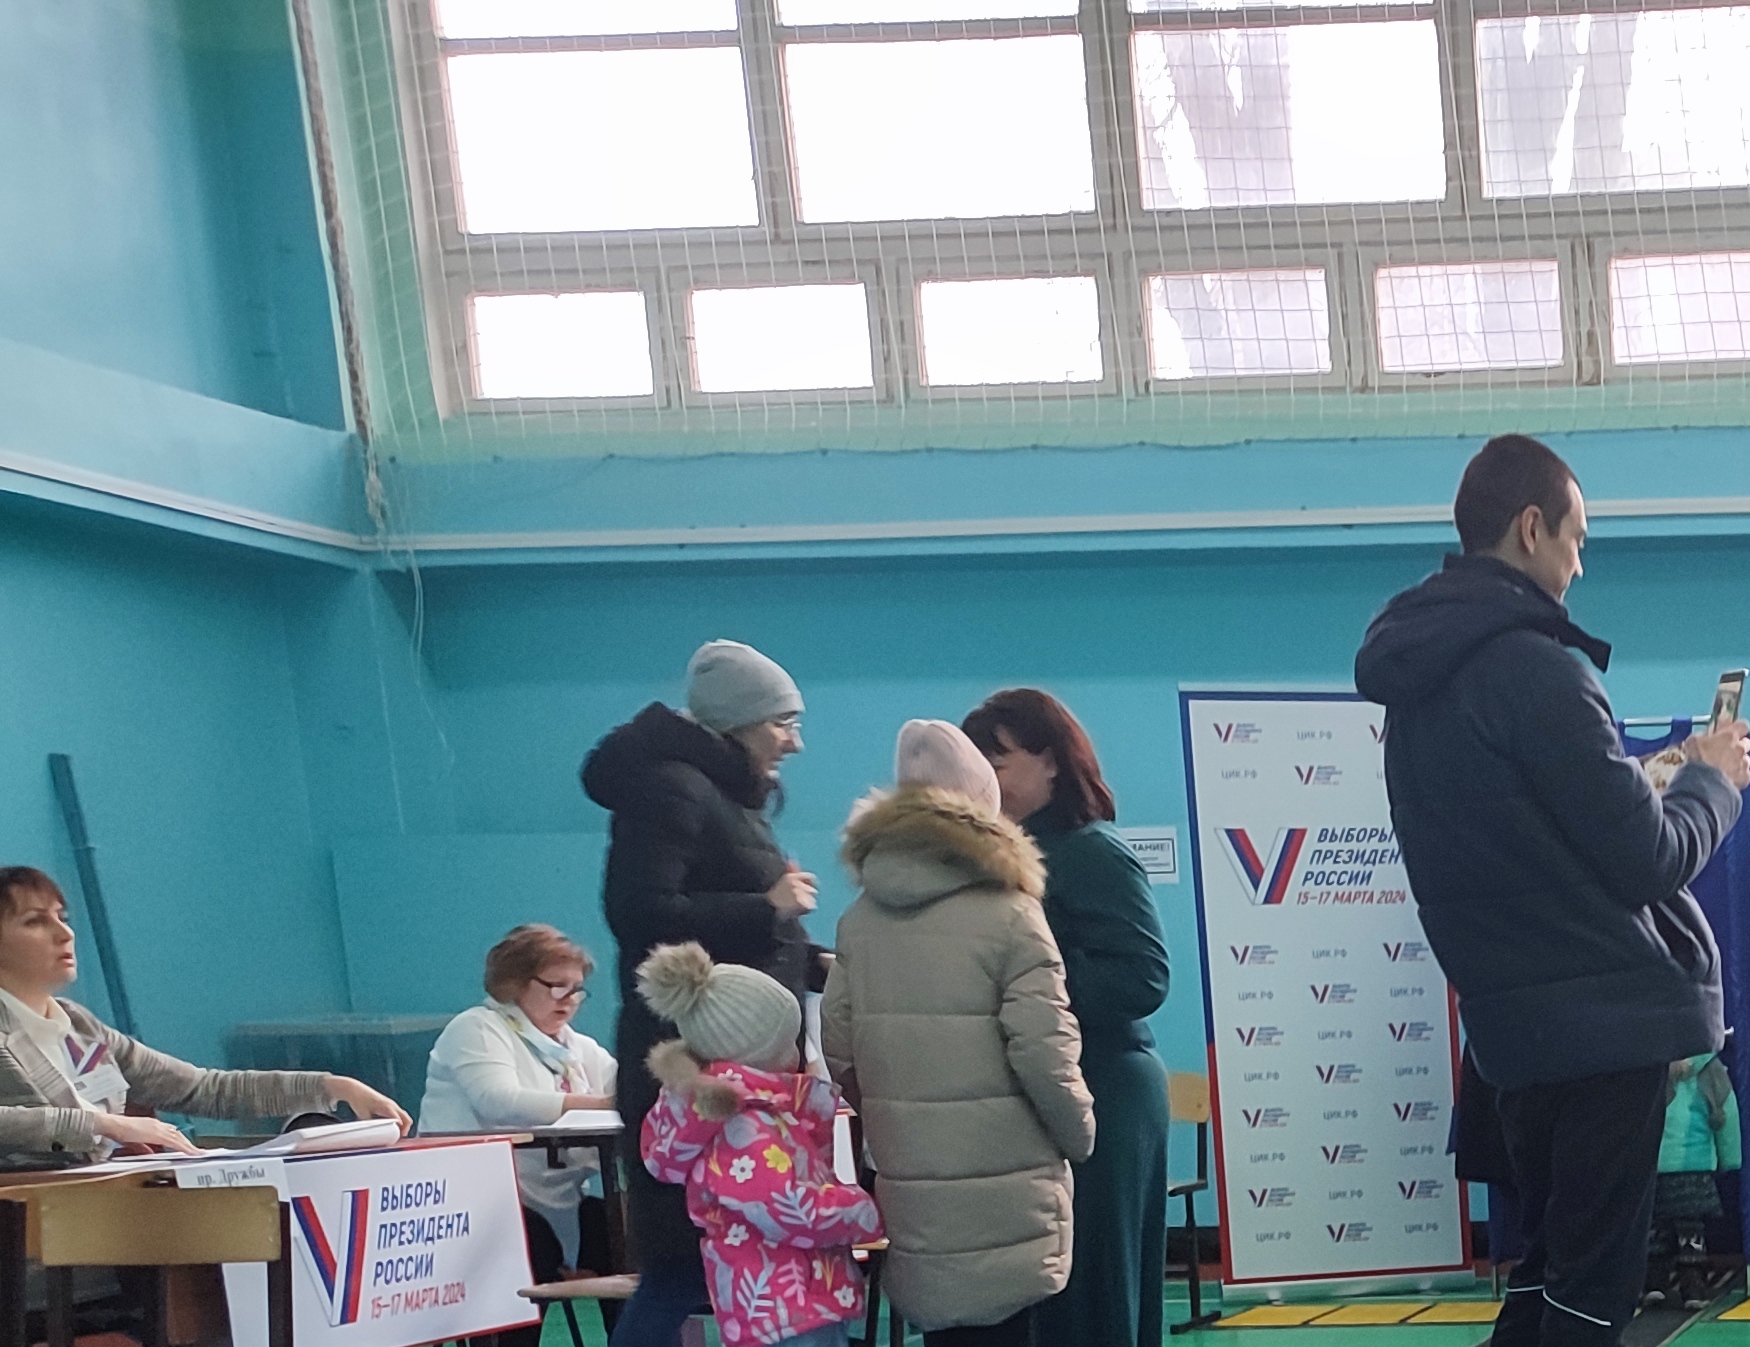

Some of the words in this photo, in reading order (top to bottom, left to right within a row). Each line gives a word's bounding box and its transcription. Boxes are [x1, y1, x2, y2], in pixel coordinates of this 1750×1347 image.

[1317, 827, 1395, 843] ВЫБОРЫ
[1309, 848, 1405, 866] ПРЕЗИДЕН
[1302, 870, 1373, 887] РОССИИ
[1332, 890, 1374, 905] МАРТА
[1376, 890, 1406, 905] 2024
[380, 1178, 447, 1212] ВЫБОРЫ
[377, 1211, 470, 1250] ПРЕЗИДЕНТА
[373, 1251, 434, 1288] РОССИИ
[403, 1283, 440, 1313] МАРТА
[441, 1281, 467, 1307] 2024
